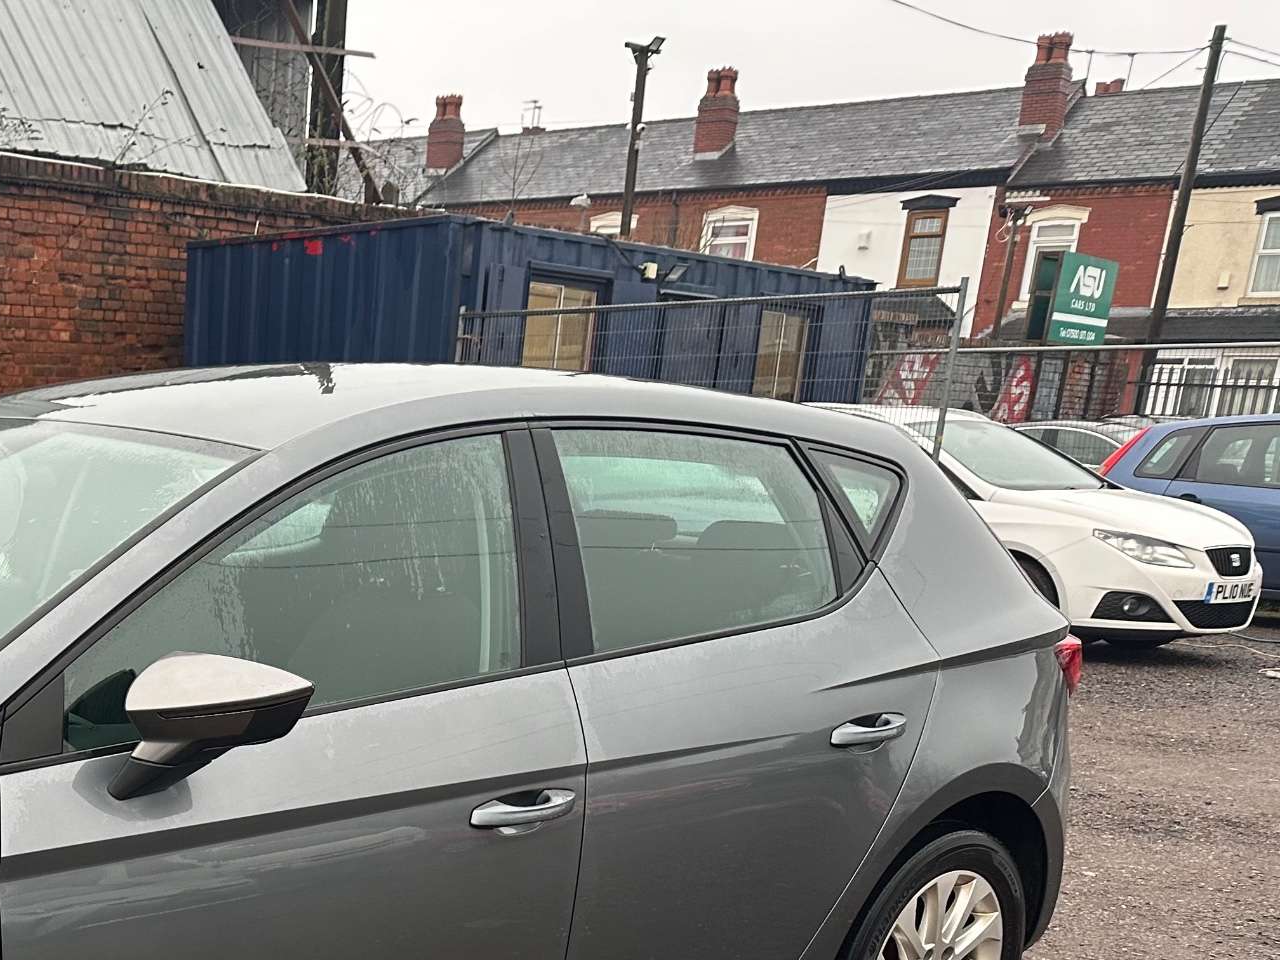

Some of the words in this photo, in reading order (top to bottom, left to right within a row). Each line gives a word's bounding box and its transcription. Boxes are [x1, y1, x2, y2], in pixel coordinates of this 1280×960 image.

[1071, 298, 1085, 310] CARS
[1085, 302, 1096, 312] LTD
[1215, 584, 1239, 600] PL10
